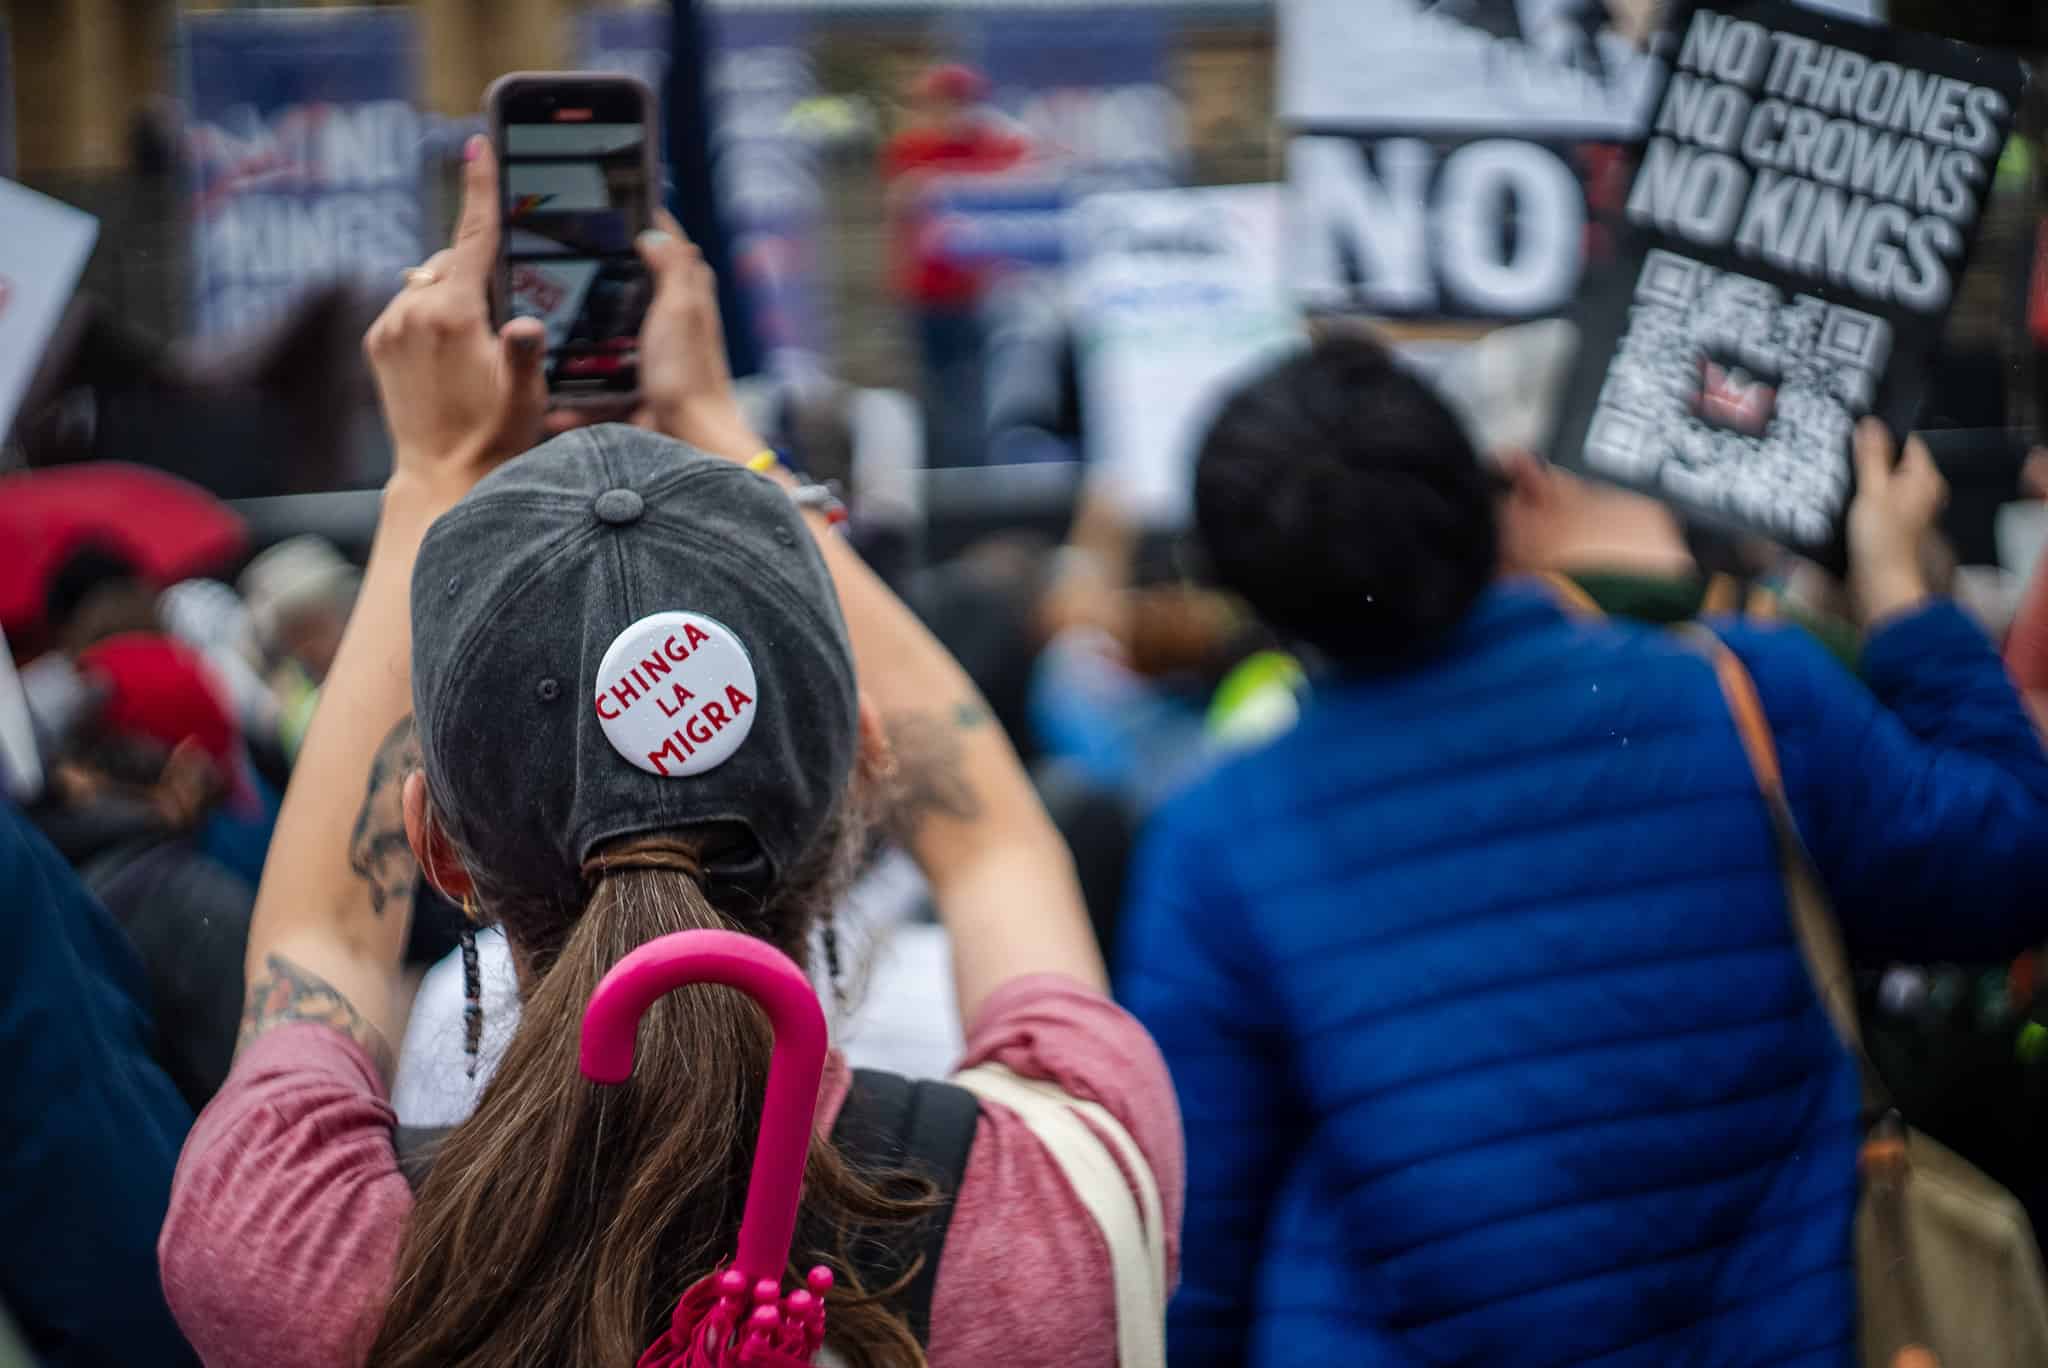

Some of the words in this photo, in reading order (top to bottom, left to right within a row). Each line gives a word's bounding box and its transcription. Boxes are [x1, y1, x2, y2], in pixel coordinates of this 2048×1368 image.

[1676, 10, 1769, 88] NO
[1764, 30, 2011, 154] THRONES
[1654, 72, 1752, 151] NO
[1742, 97, 1986, 224] CROWNS
[1626, 137, 1750, 246] NO
[1733, 167, 1962, 311] KINGS
[595, 623, 710, 720] CHINGA
[648, 684, 753, 777] MIGRA
[656, 683, 696, 718] LA
